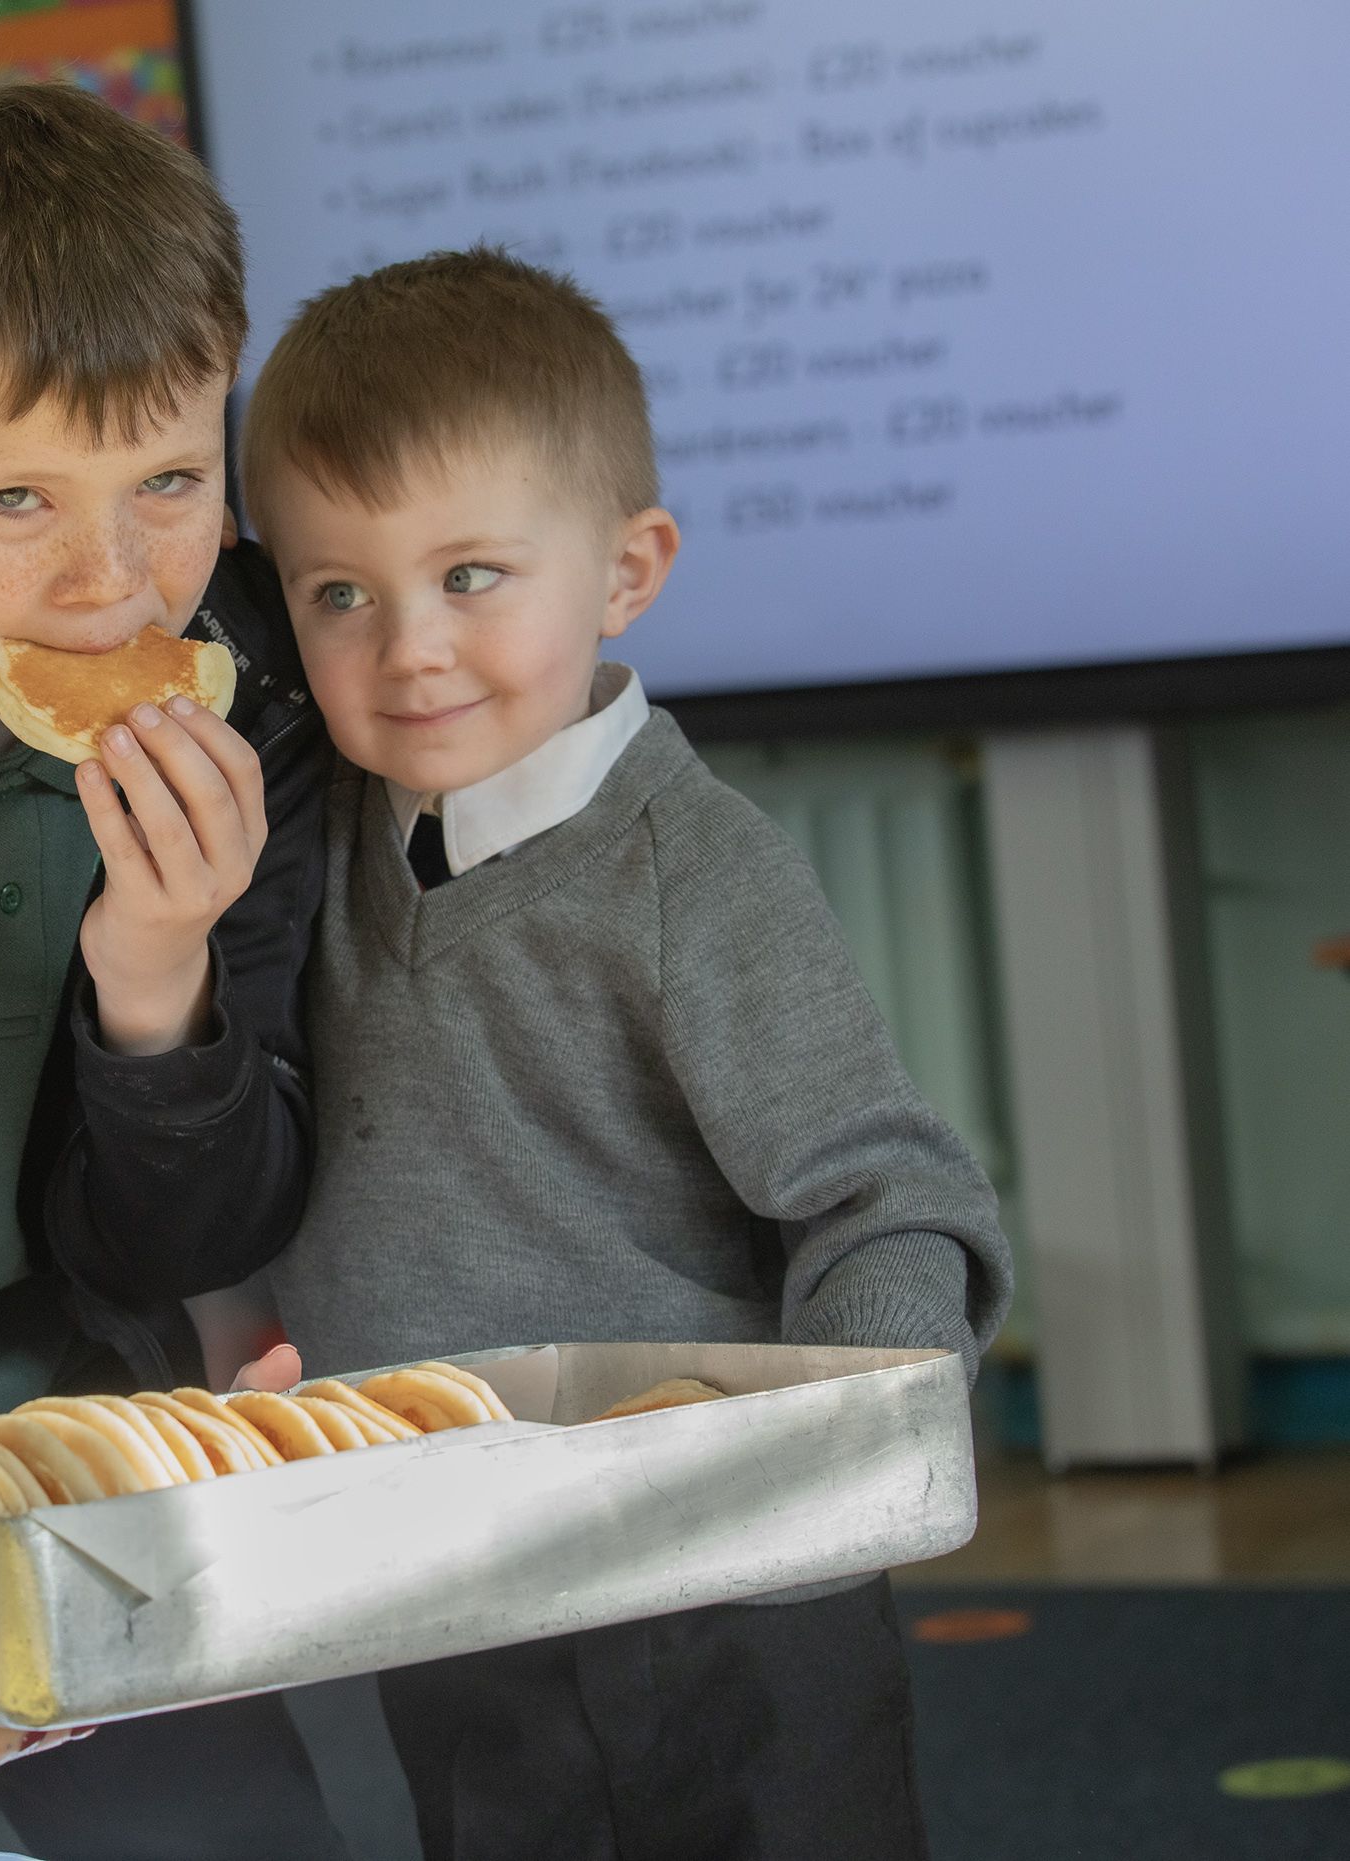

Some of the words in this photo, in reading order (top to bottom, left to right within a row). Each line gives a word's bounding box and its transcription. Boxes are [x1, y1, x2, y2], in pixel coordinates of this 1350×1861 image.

[807, 39, 887, 94] £20
[894, 27, 1045, 80] voucher
[798, 120, 874, 166] Box
[882, 107, 928, 167] of
[935, 95, 1107, 156] cupcakes
[604, 211, 684, 261] £20
[690, 199, 837, 250] voucher
[743, 271, 802, 329] for
[889, 258, 993, 312] pizza
[715, 342, 796, 391] £20
[802, 330, 951, 381] voucher
[885, 396, 967, 447] £20
[976, 384, 1128, 436] voucher
[810, 476, 958, 524] voucher
